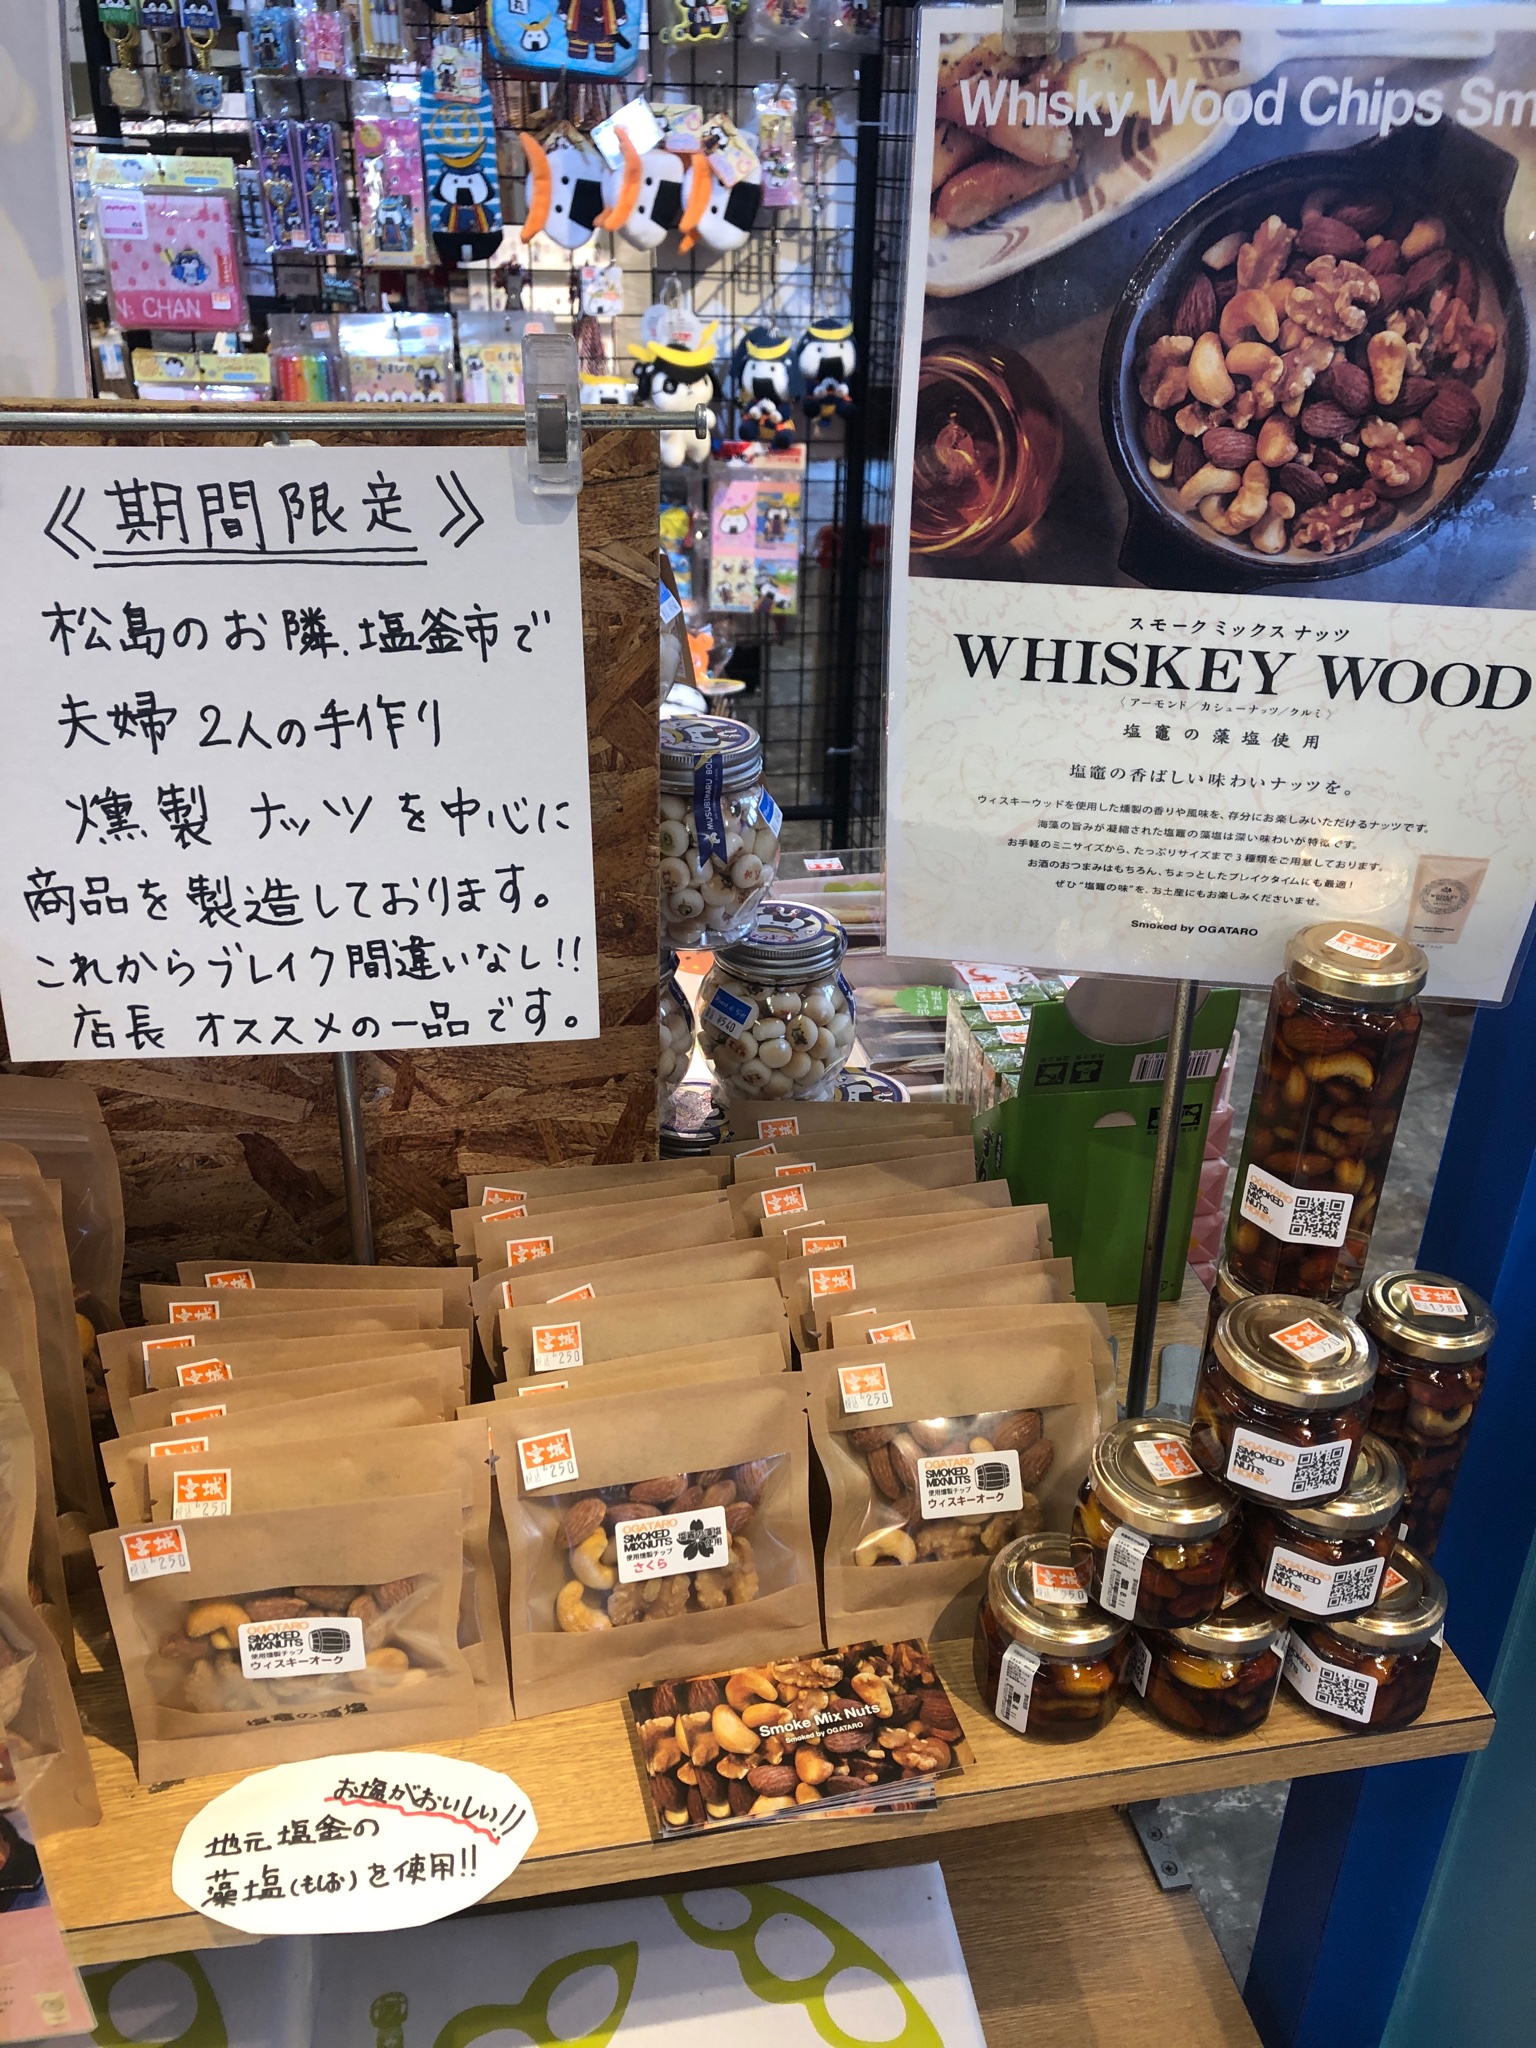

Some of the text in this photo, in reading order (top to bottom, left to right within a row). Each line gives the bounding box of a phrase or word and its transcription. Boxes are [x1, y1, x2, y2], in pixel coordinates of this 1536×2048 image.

[961, 75, 1536, 137] Whisky Wood Chips Sm
[142, 297, 201, 320] CHAN
[953, 633, 1532, 709] WHISKEY WOOD
[1131, 919, 1259, 936] Smoked by OGATARO
[1248, 1182, 1284, 1208] SMOKED
[1246, 1196, 1269, 1215] NUTS
[1235, 1452, 1256, 1465] MIX
[1236, 1445, 1285, 1467] SMOKED
[1238, 1438, 1296, 1463] OGATARO
[924, 1456, 975, 1469] OGATARO
[1233, 1460, 1265, 1476] NUTS
[925, 1466, 968, 1479] SMOKED
[622, 1518, 678, 1534] OGATARO
[623, 1528, 670, 1543] SMOKED
[633, 1558, 667, 1573] さくら
[1275, 1562, 1321, 1585] SMOKED
[1274, 1569, 1292, 1581] MIX
[1272, 1576, 1302, 1592] NUTS
[247, 1621, 309, 1635] OGATARO
[247, 1630, 300, 1643] SMOKED
[759, 1704, 880, 1737] Smoke Mix Nuts
[785, 1721, 864, 1744] Smoked by OGATARO
